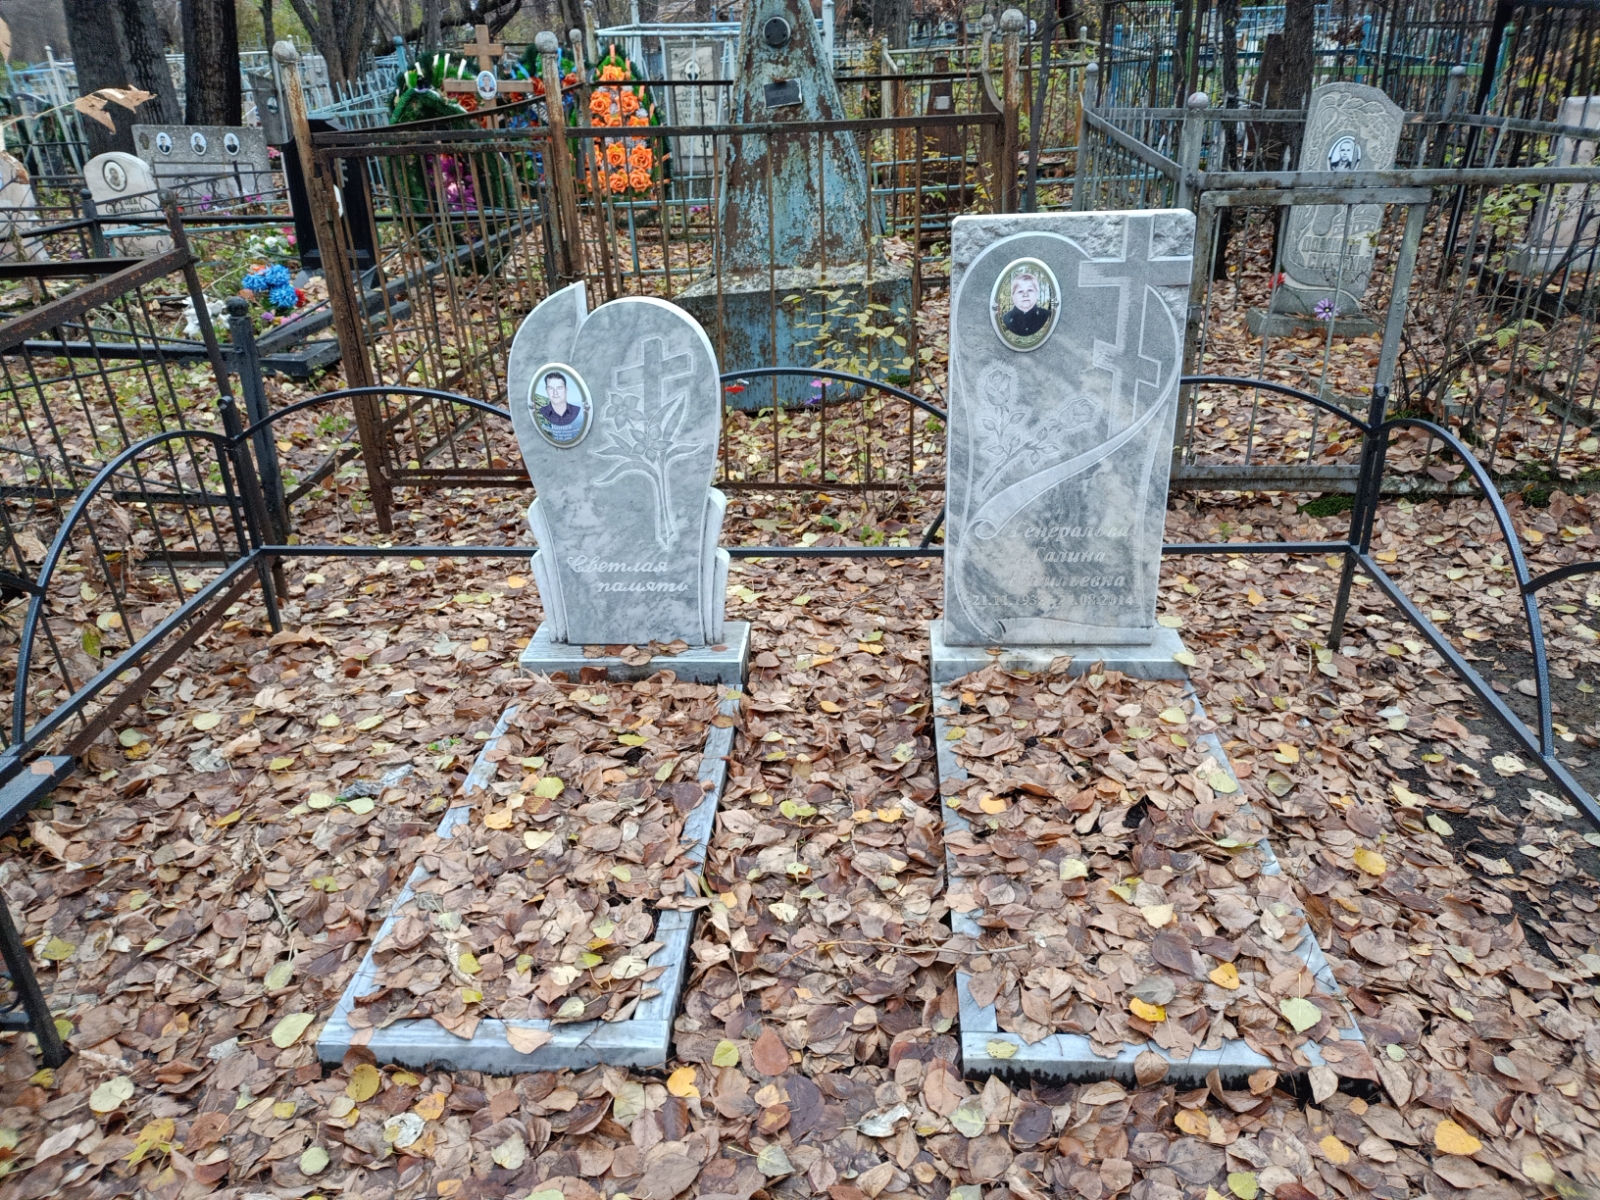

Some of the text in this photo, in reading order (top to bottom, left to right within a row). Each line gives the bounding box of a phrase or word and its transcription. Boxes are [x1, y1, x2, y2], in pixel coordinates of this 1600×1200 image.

[1031, 547, 1106, 562] Галина
[566, 554, 669, 574] Светлая
[596, 581, 690, 593] память
